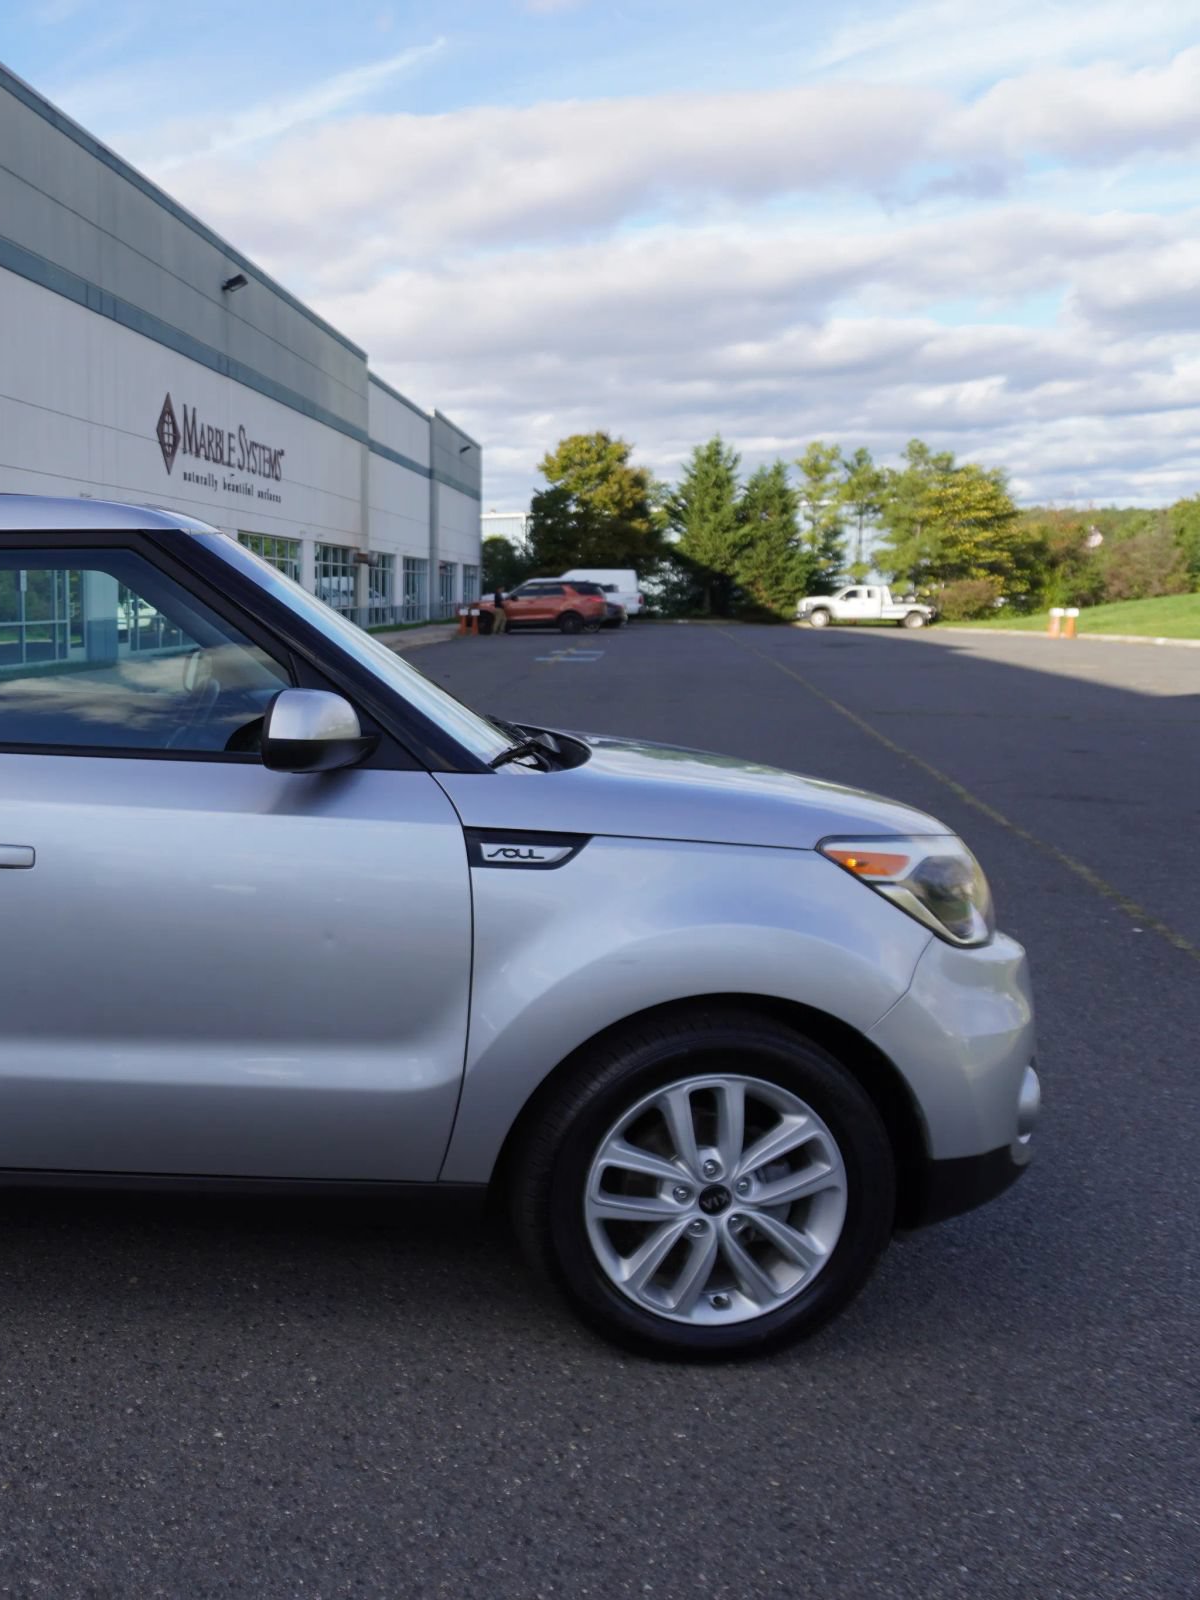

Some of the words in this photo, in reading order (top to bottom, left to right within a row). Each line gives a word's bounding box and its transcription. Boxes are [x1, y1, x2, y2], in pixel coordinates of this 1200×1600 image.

[182, 403, 236, 469] MARBLE
[183, 471, 218, 492] naturally
[223, 477, 254, 497] beautiful
